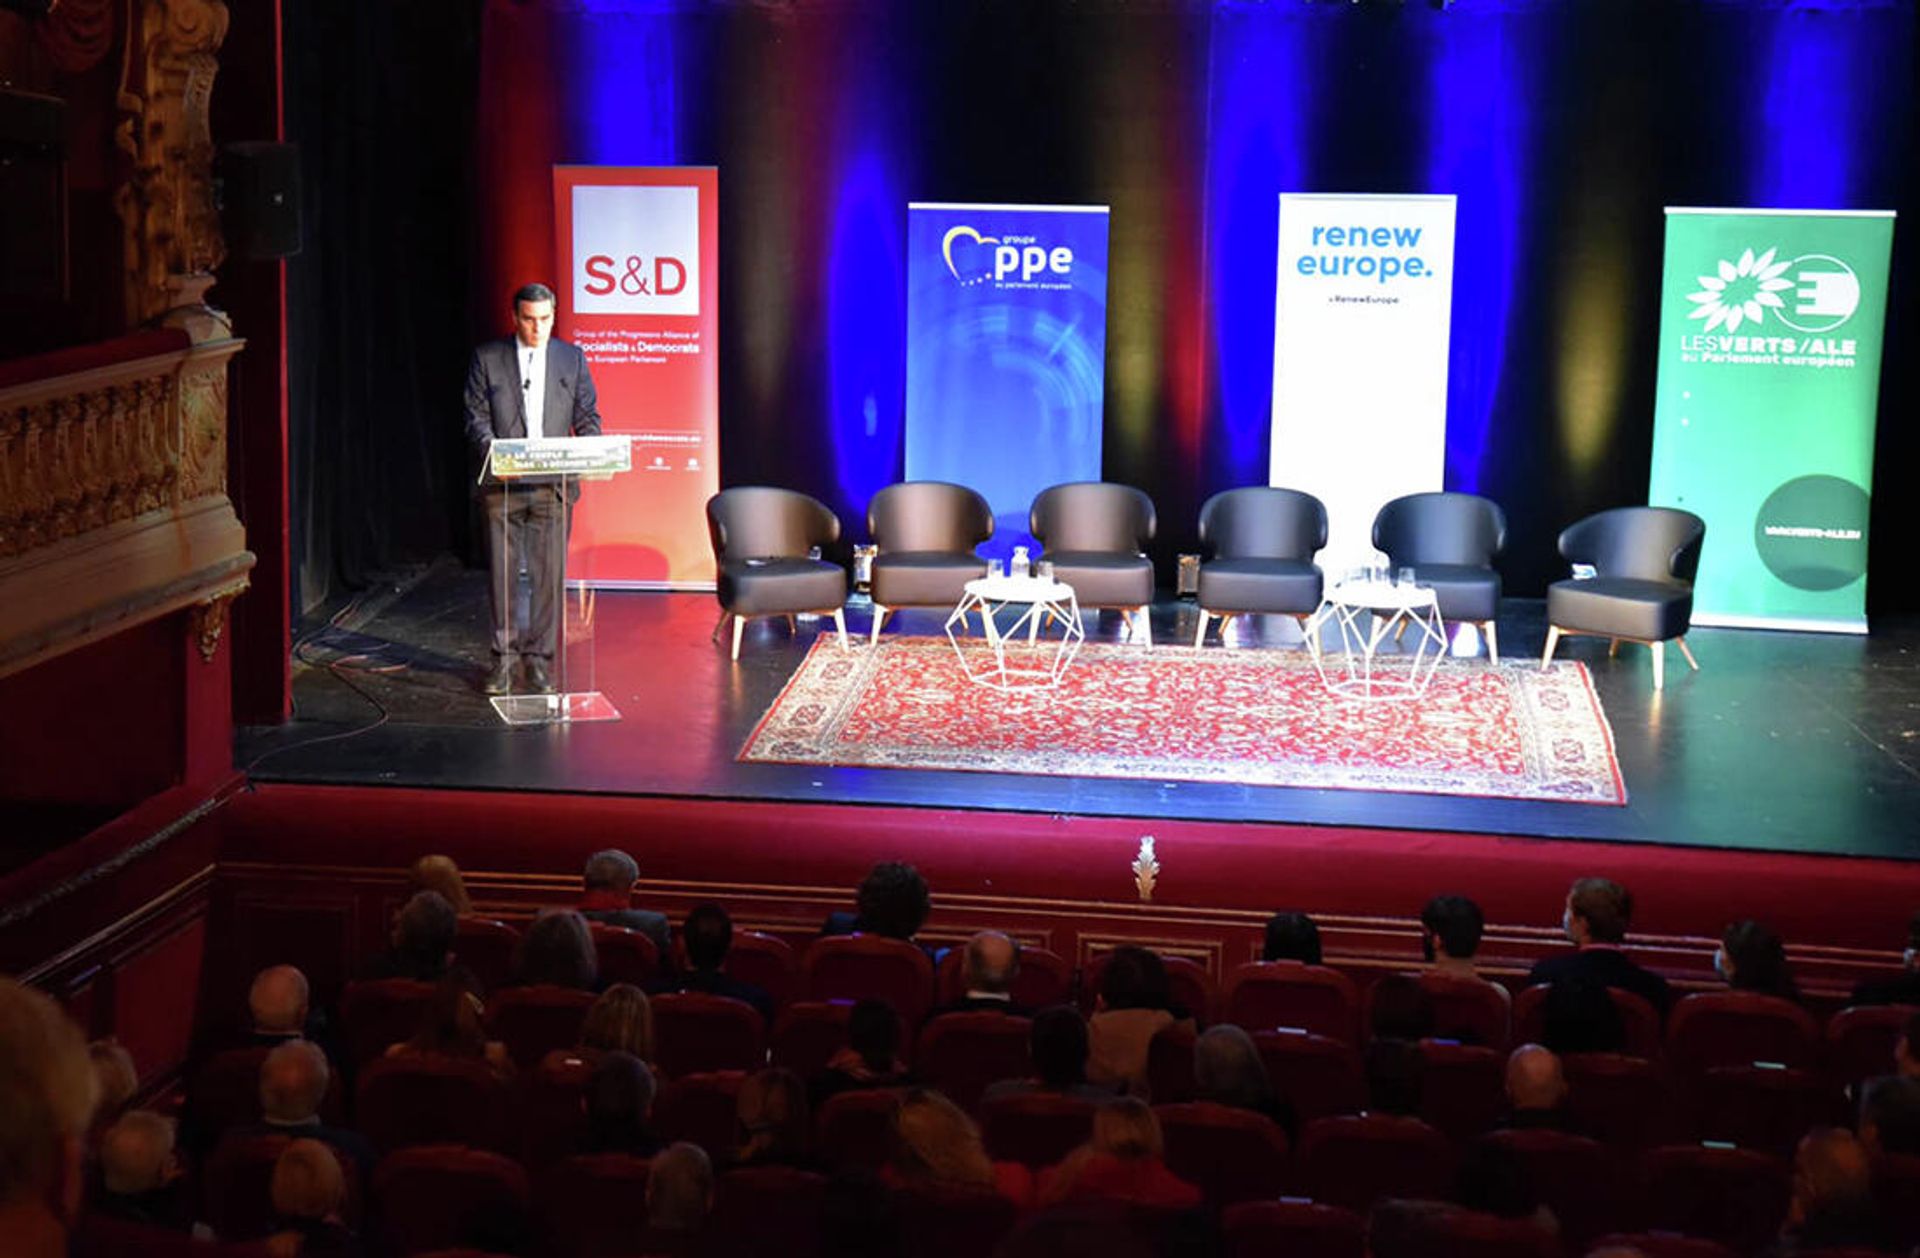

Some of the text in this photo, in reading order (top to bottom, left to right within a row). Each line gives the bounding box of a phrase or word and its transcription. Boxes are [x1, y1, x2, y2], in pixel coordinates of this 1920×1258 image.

[1312, 226, 1422, 247] renew
[584, 255, 687, 295] S&D
[995, 246, 1073, 280] ppe
[1297, 255, 1433, 284] europe.
[637, 341, 700, 353] Democrats
[1701, 352, 1779, 364] Parlement
[1783, 355, 1856, 368] européen
